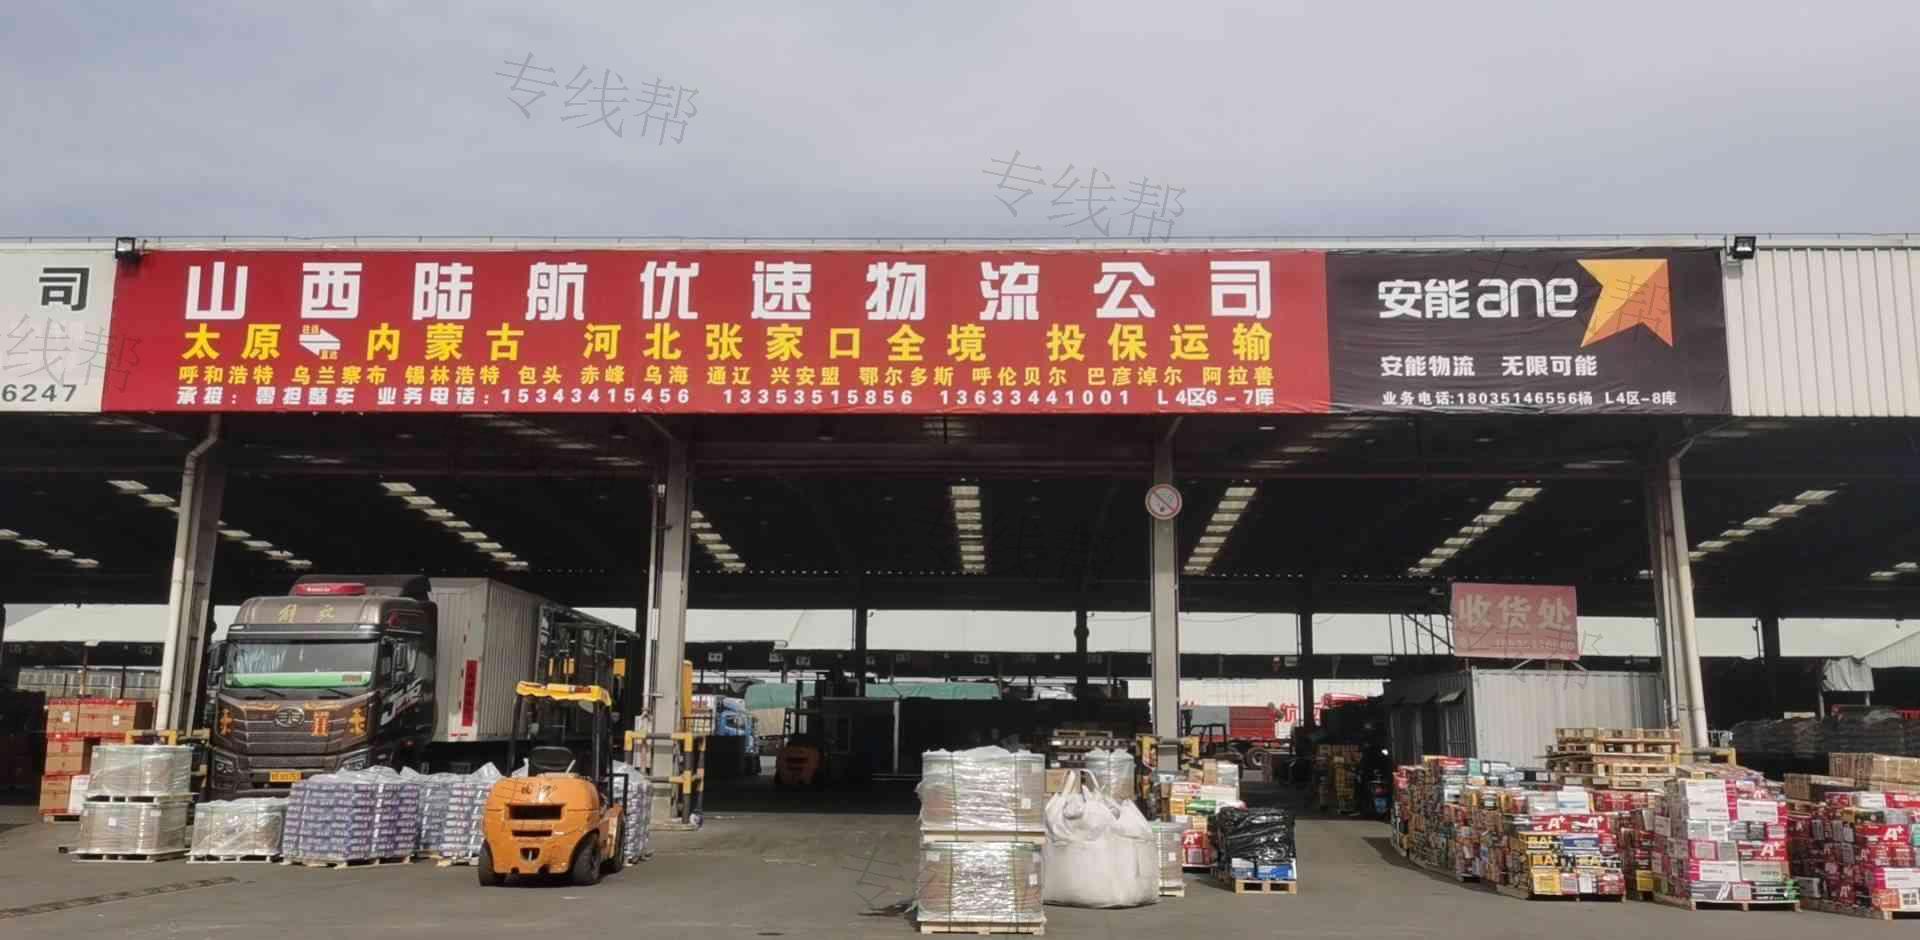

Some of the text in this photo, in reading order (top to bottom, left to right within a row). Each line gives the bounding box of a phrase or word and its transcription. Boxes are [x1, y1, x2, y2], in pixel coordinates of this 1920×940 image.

[39, 268, 89, 311] 司
[184, 260, 1272, 321] 山西陆航优速物流公司
[1377, 278, 1577, 319] 安能 ane
[183, 322, 1272, 362] 太原 内蒙古 河北张家口全境 投保运输
[178, 365, 1274, 386] 呼和浩特 乌兰察布 锡林浩特 包头 赤峰 乌海 通辽 兴安盟 鄂尔多斯 呼伦贝尔 巴彦淖尔 阿拉善
[1381, 355, 1597, 376] 安能物流 无限可能
[2, 384, 77, 402] 6247
[723, 388, 912, 405] 13353515856
[940, 389, 1129, 405] 13633441001
[1458, 593, 1571, 632] 收货处
